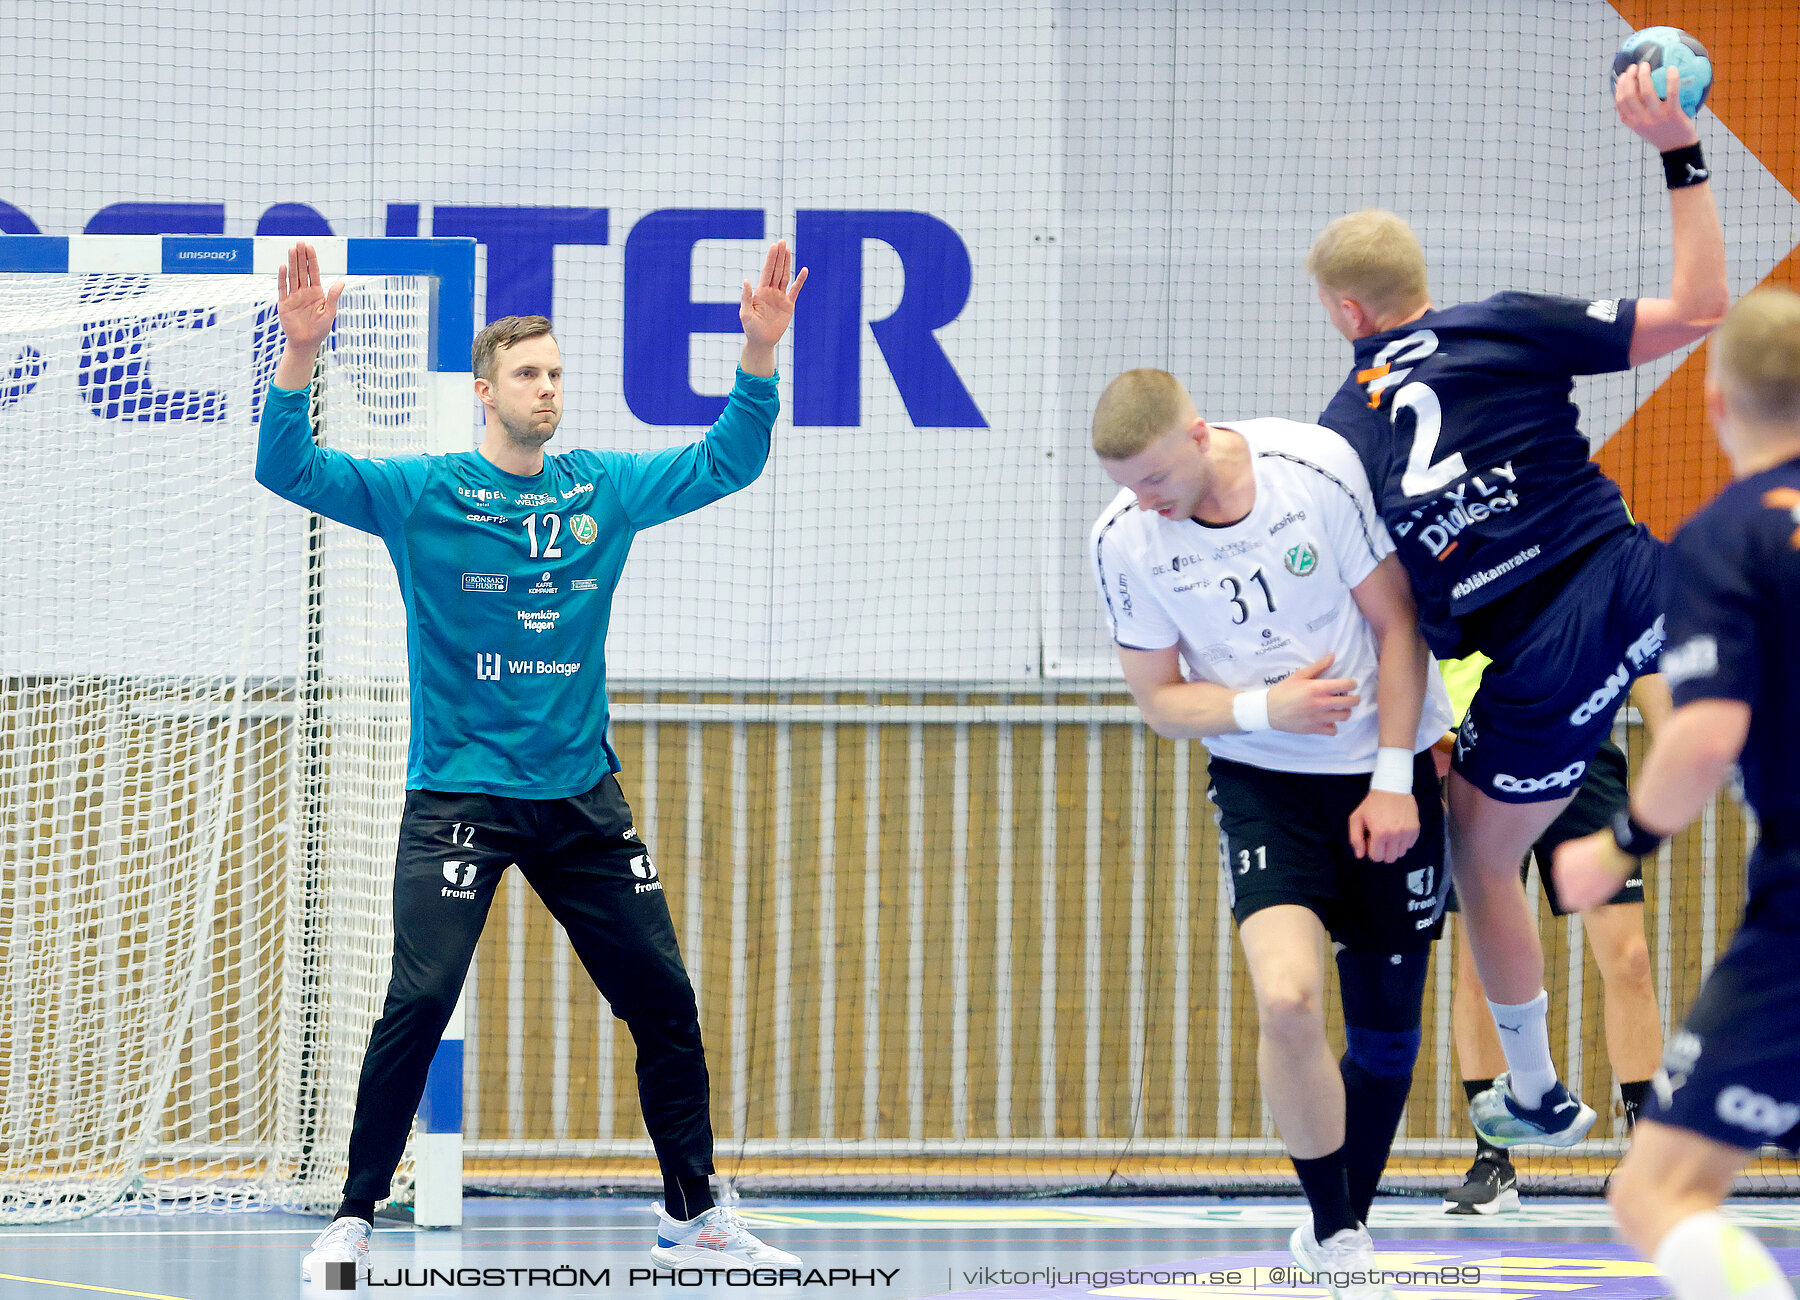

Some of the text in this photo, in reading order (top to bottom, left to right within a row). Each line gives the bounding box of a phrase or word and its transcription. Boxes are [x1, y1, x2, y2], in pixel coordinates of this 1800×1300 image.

[179, 251, 231, 259] UNISPORT
[1391, 381, 1467, 497] 2
[466, 514, 499, 523] CRAFT
[1418, 489, 1519, 558] Dialect
[522, 513, 562, 558] 12
[1451, 544, 1541, 600] #blåkamrater
[1221, 567, 1278, 625] 31
[517, 610, 560, 621] Hemköp
[523, 620, 555, 634] Hagen
[508, 660, 533, 674] WH
[1492, 760, 1586, 794] coop
[452, 822, 476, 848] 12
[1238, 846, 1266, 875] 31
[441, 886, 475, 900] fronta
